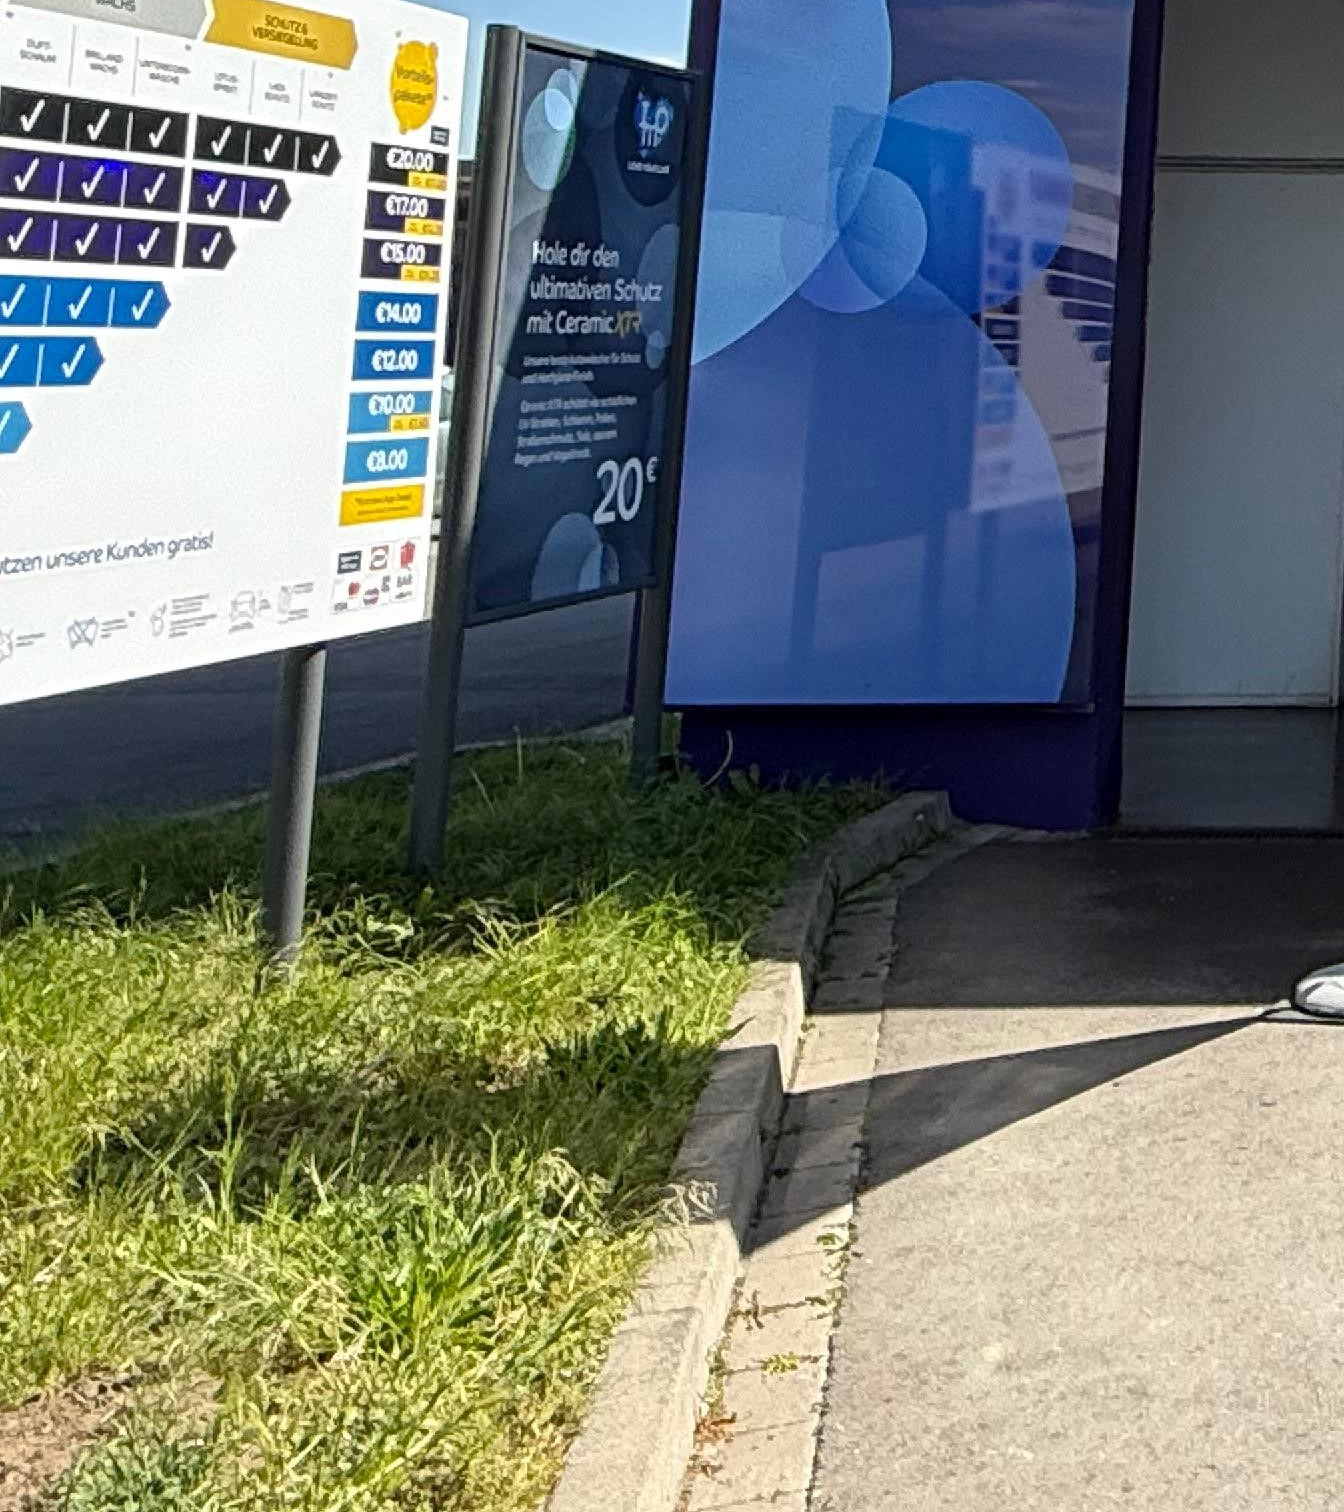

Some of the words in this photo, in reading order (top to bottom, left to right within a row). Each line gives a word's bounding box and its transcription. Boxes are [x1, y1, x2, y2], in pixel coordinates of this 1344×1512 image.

[386, 147, 434, 172] €20.00
[385, 194, 429, 218] €17.00
[380, 242, 426, 264] €15.00
[532, 239, 568, 265] Hole
[570, 244, 590, 267] dir
[592, 242, 620, 269] den
[530, 275, 611, 301] ultimativen
[614, 278, 662, 302] Schutz
[375, 300, 422, 324] €14.00
[526, 309, 552, 334] mit
[371, 348, 418, 372] €12.00
[46, 547, 104, 570] unsere
[106, 537, 165, 562] Kunden
[167, 530, 214, 560] gratis!
